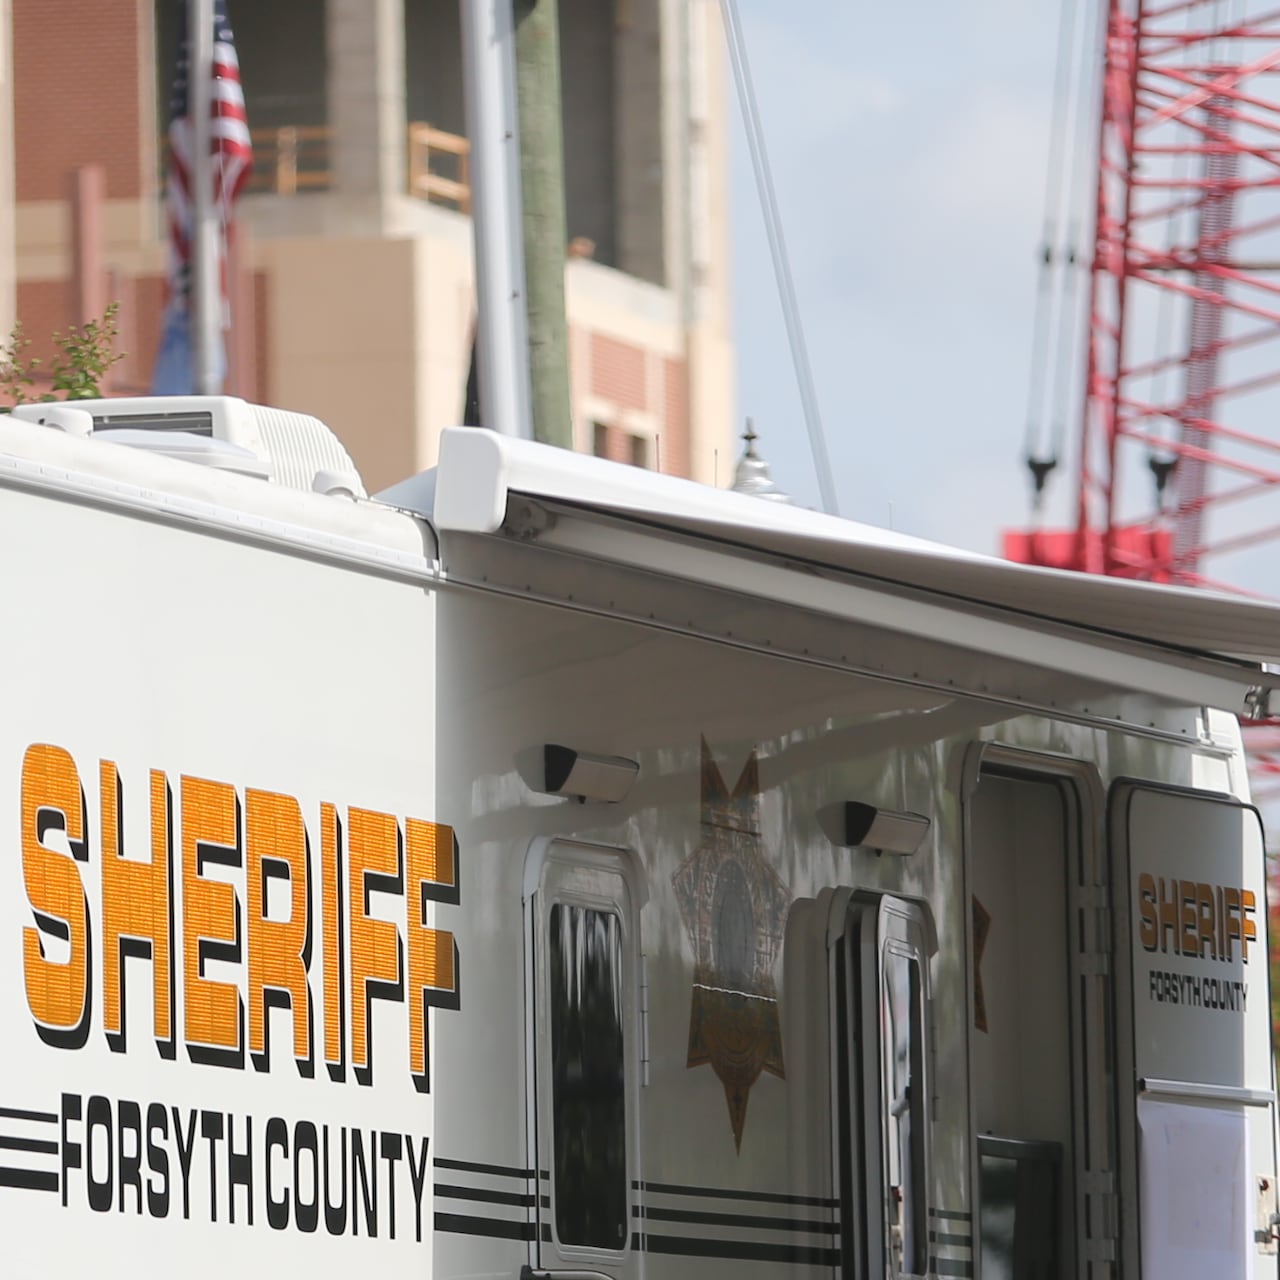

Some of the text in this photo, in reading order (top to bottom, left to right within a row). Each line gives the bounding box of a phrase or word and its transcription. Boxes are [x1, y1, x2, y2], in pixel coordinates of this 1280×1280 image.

[20, 742, 461, 1094] SHERIFF
[1138, 873, 1256, 964] SHERIFF
[1150, 970, 1248, 1012] FORSYTH COUNTY
[61, 1092, 429, 1242] FORSYTH COUNTY
